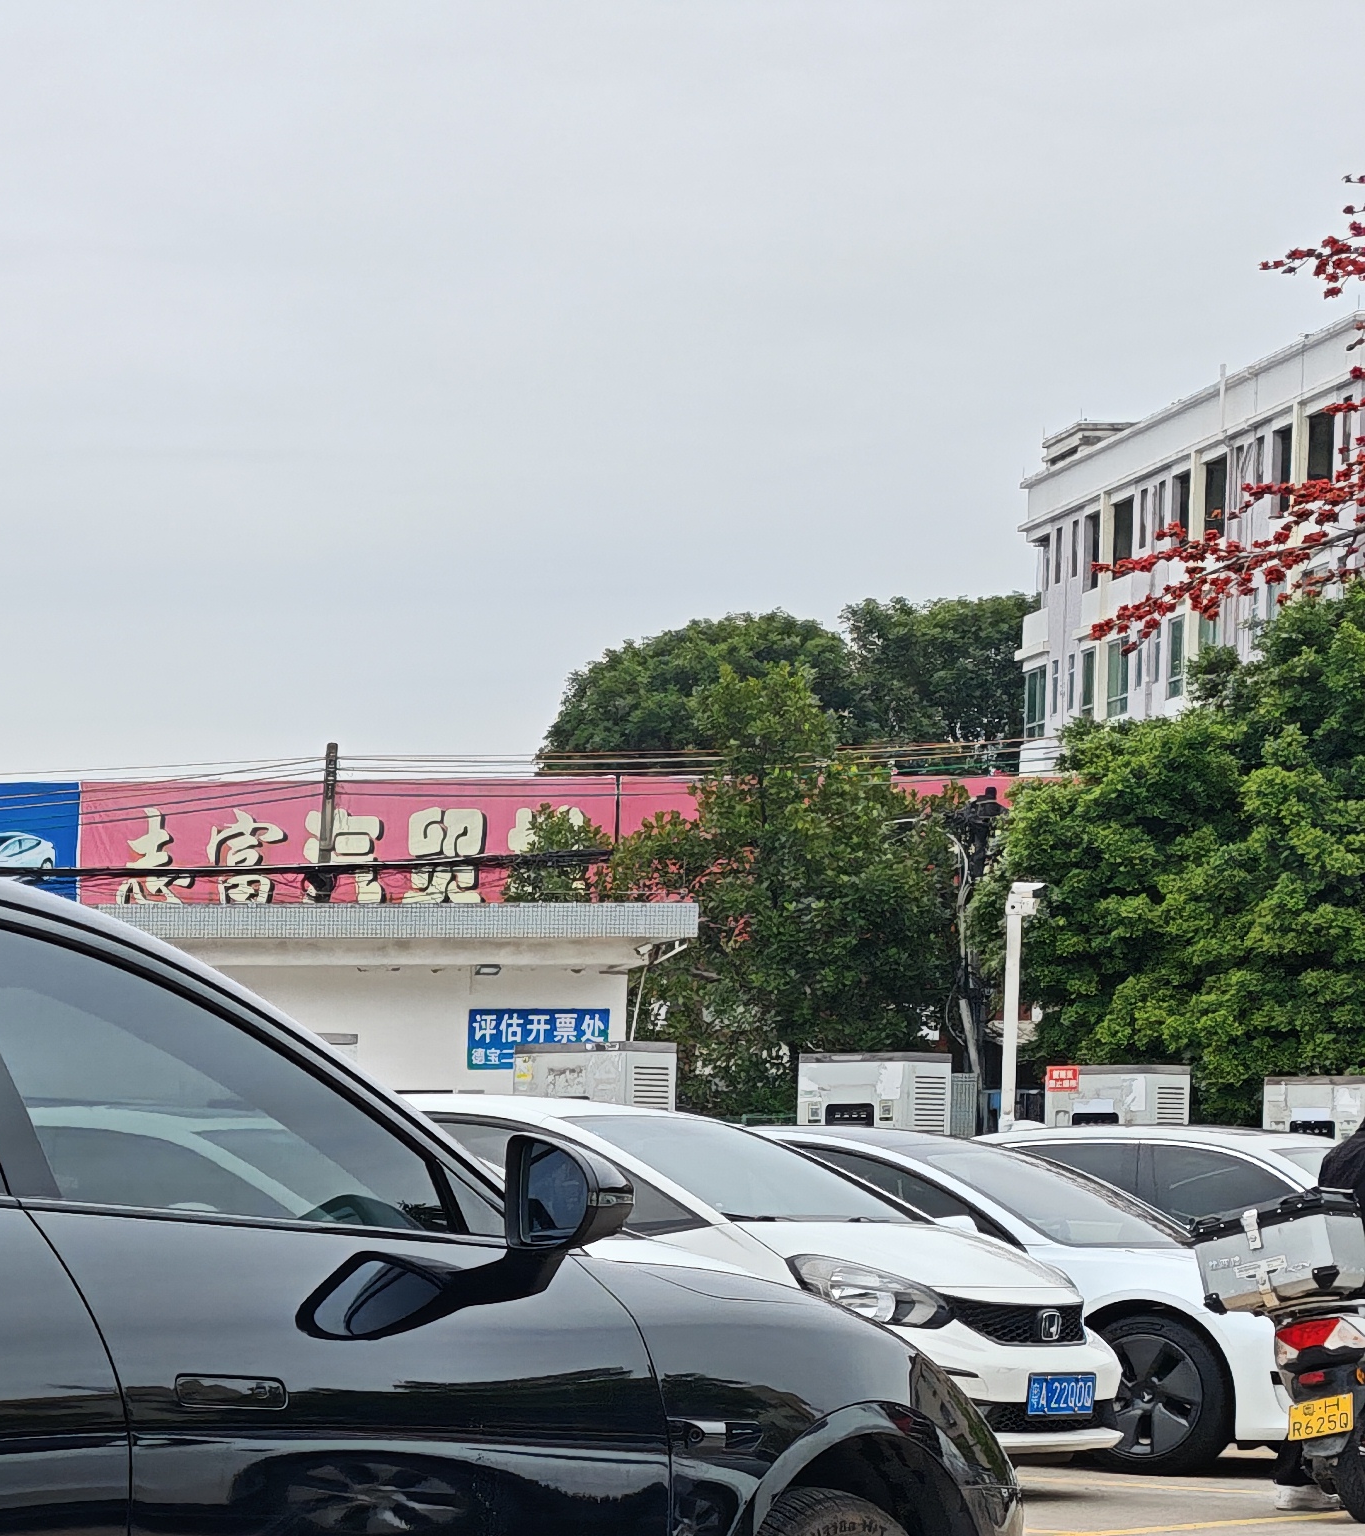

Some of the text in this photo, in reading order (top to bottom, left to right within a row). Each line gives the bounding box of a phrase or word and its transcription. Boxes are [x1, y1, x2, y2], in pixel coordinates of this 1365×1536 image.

[472, 1013, 605, 1044] 评估开票处
